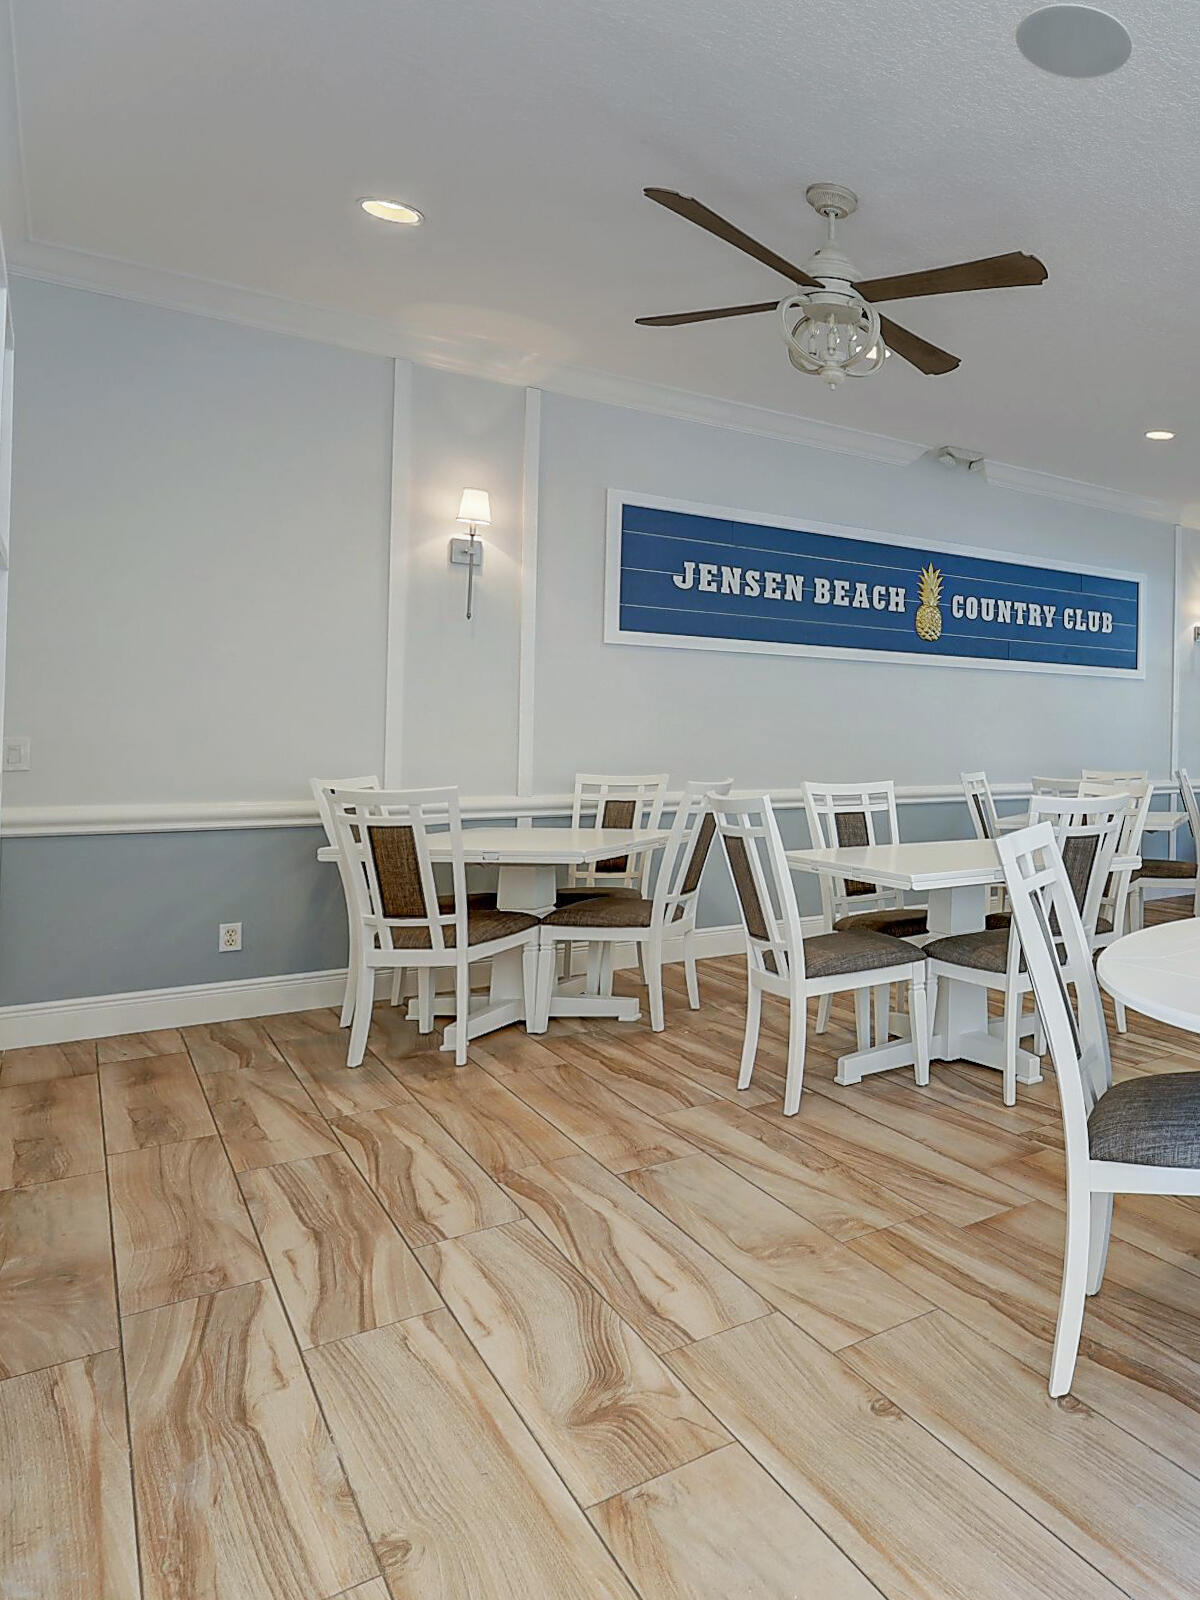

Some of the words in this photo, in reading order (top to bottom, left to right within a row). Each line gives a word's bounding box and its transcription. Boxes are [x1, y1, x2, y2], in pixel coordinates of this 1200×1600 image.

[673, 561, 804, 602] JENSEN
[814, 578, 906, 613] BEACH
[951, 595, 1057, 629] COUNTRY
[1063, 607, 1113, 633] CLUB
